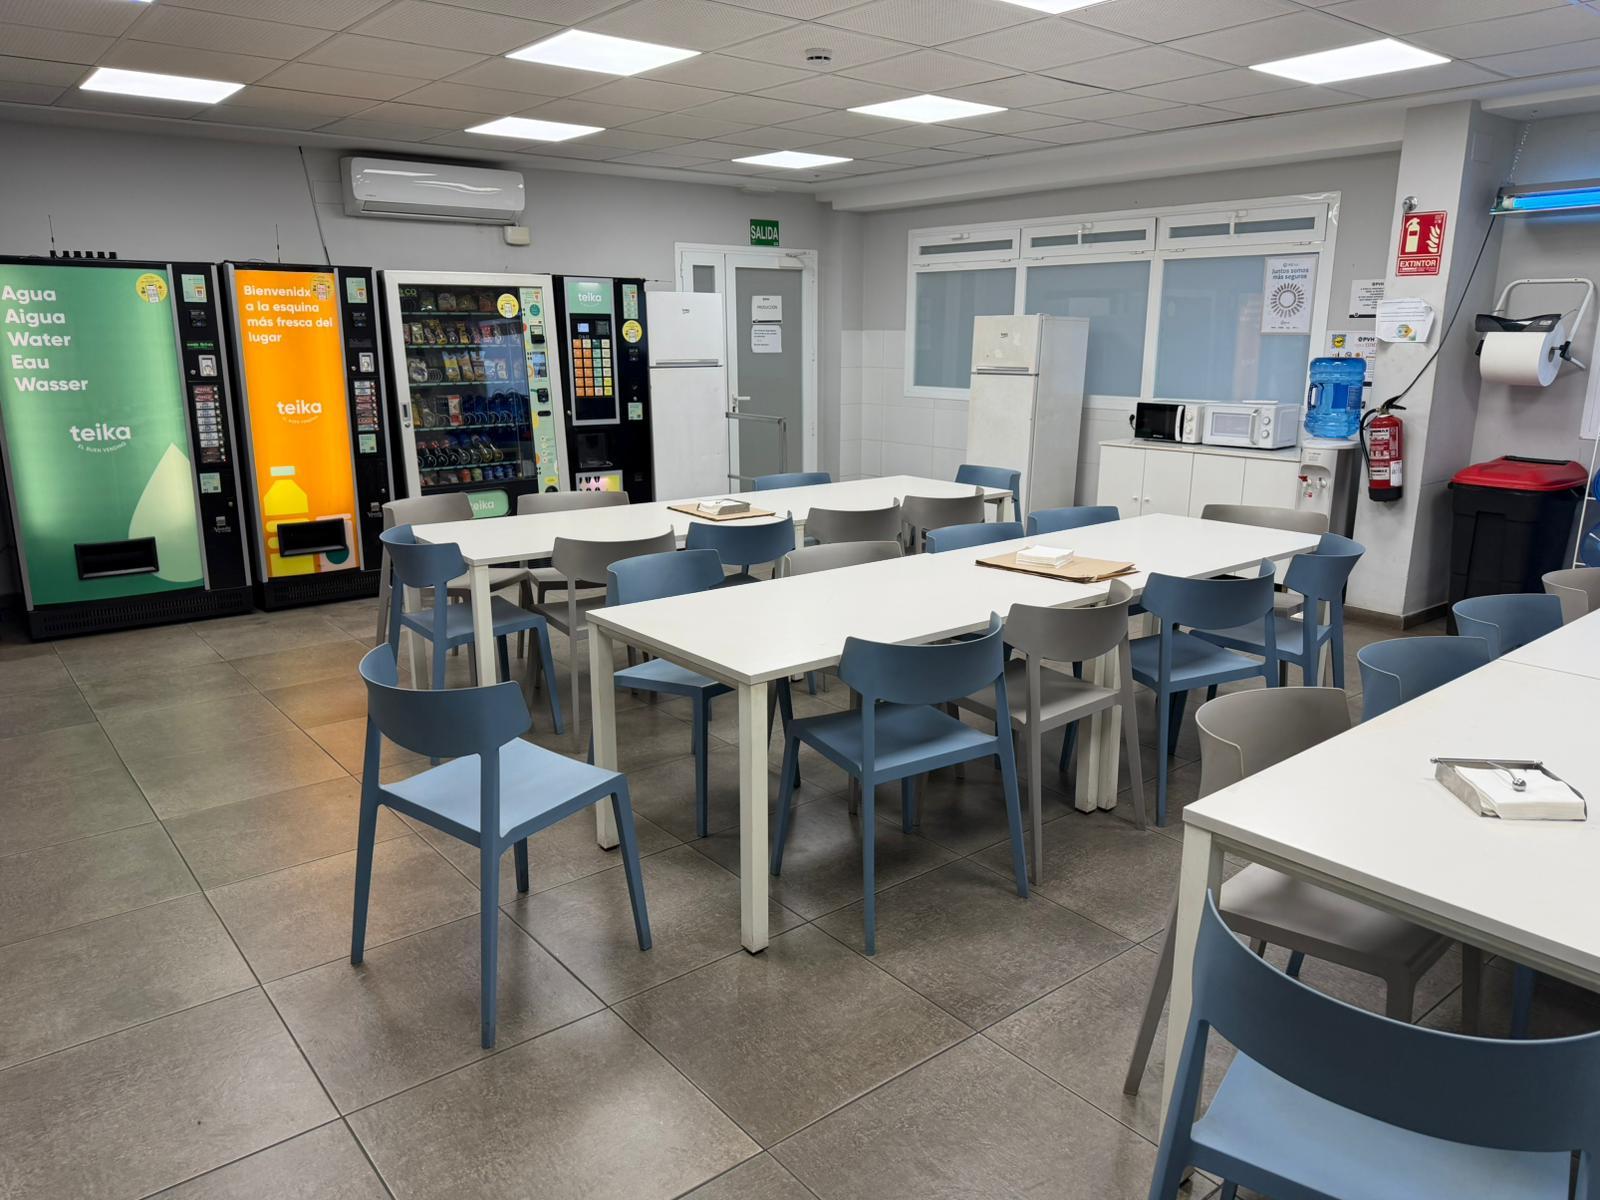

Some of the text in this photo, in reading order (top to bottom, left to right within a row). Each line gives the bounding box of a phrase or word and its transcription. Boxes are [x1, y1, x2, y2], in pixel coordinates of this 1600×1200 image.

[750, 225, 778, 240] SALIDA
[1, 285, 57, 305] Agua
[243, 285, 311, 297] Bienvenidx
[578, 292, 602, 302] teika
[245, 300, 319, 314] a la esquina
[5, 308, 66, 327] Aigua
[247, 316, 333, 328] más fresca del
[7, 331, 71, 347] Water
[248, 331, 282, 344] lugar
[11, 354, 50, 369] Eau
[14, 377, 89, 392] Wasser
[277, 399, 322, 415] teika
[69, 423, 131, 442] teika
[103, 441, 127, 453] VENDING
